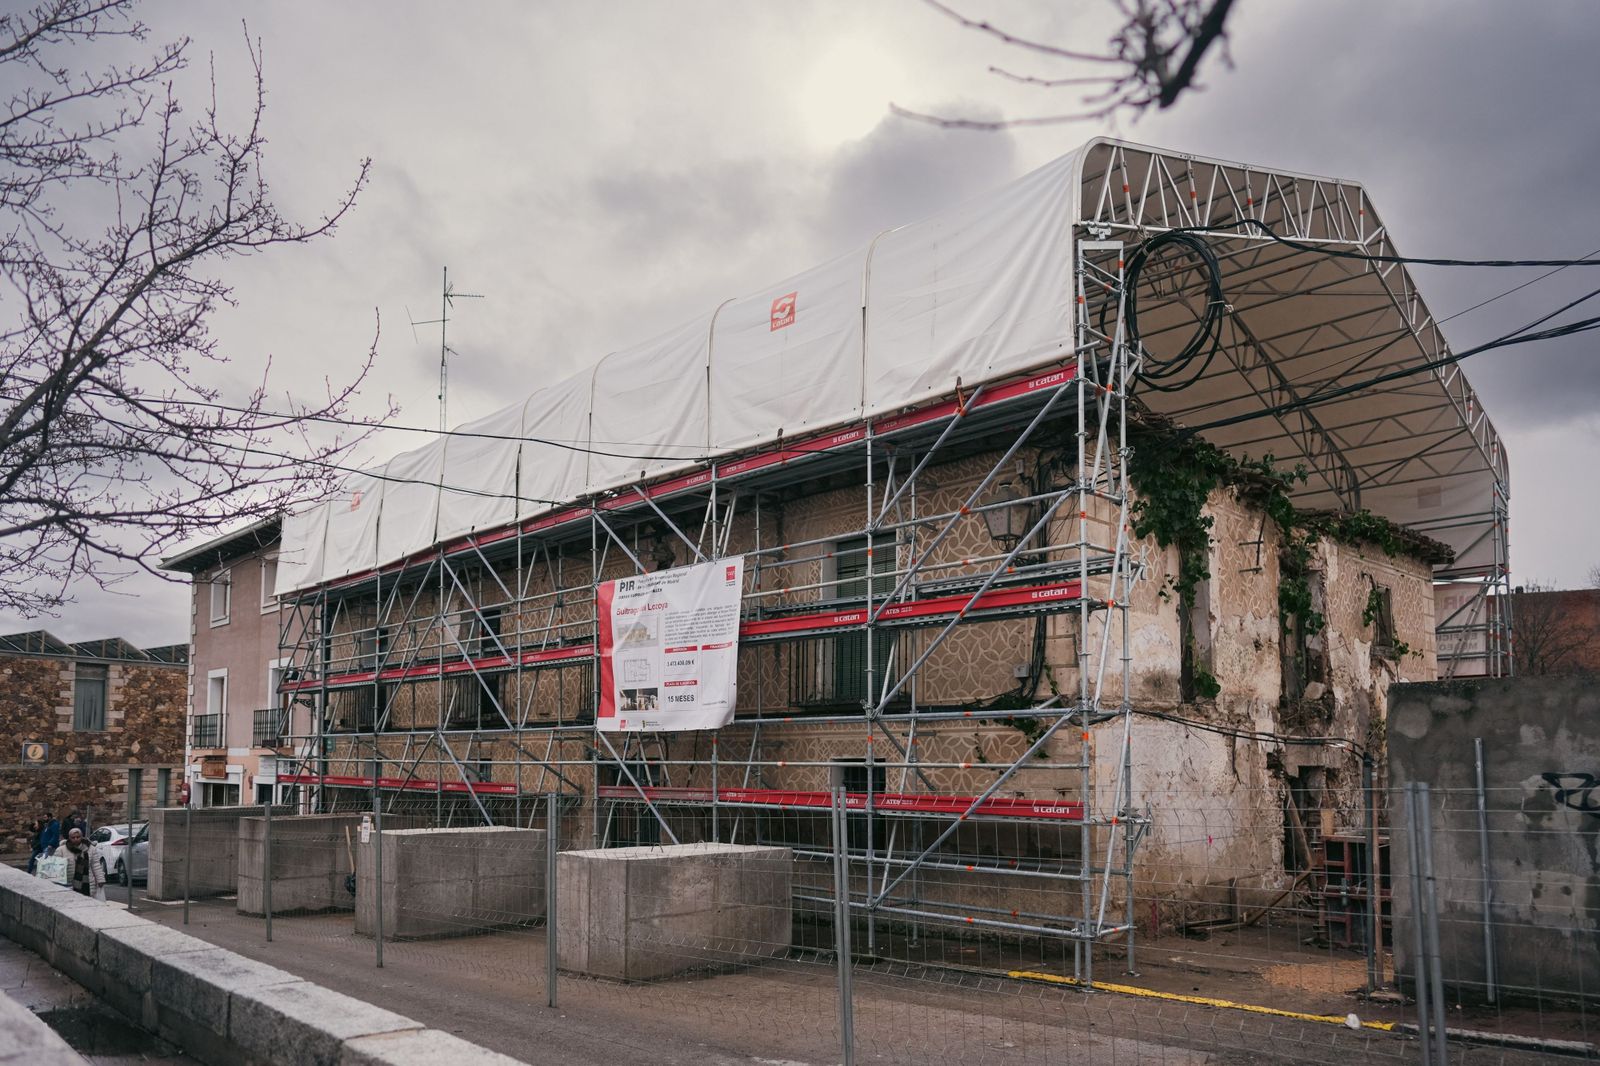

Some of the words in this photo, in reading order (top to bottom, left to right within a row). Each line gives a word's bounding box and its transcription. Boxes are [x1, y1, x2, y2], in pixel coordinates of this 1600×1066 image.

[1035, 372, 1064, 387] catari
[837, 430, 859, 444] catari
[619, 580, 635, 593] PIR
[1039, 588, 1068, 598] catari
[839, 614, 860, 622] catari
[668, 695, 674, 703] 15
[675, 694, 695, 702] MESES
